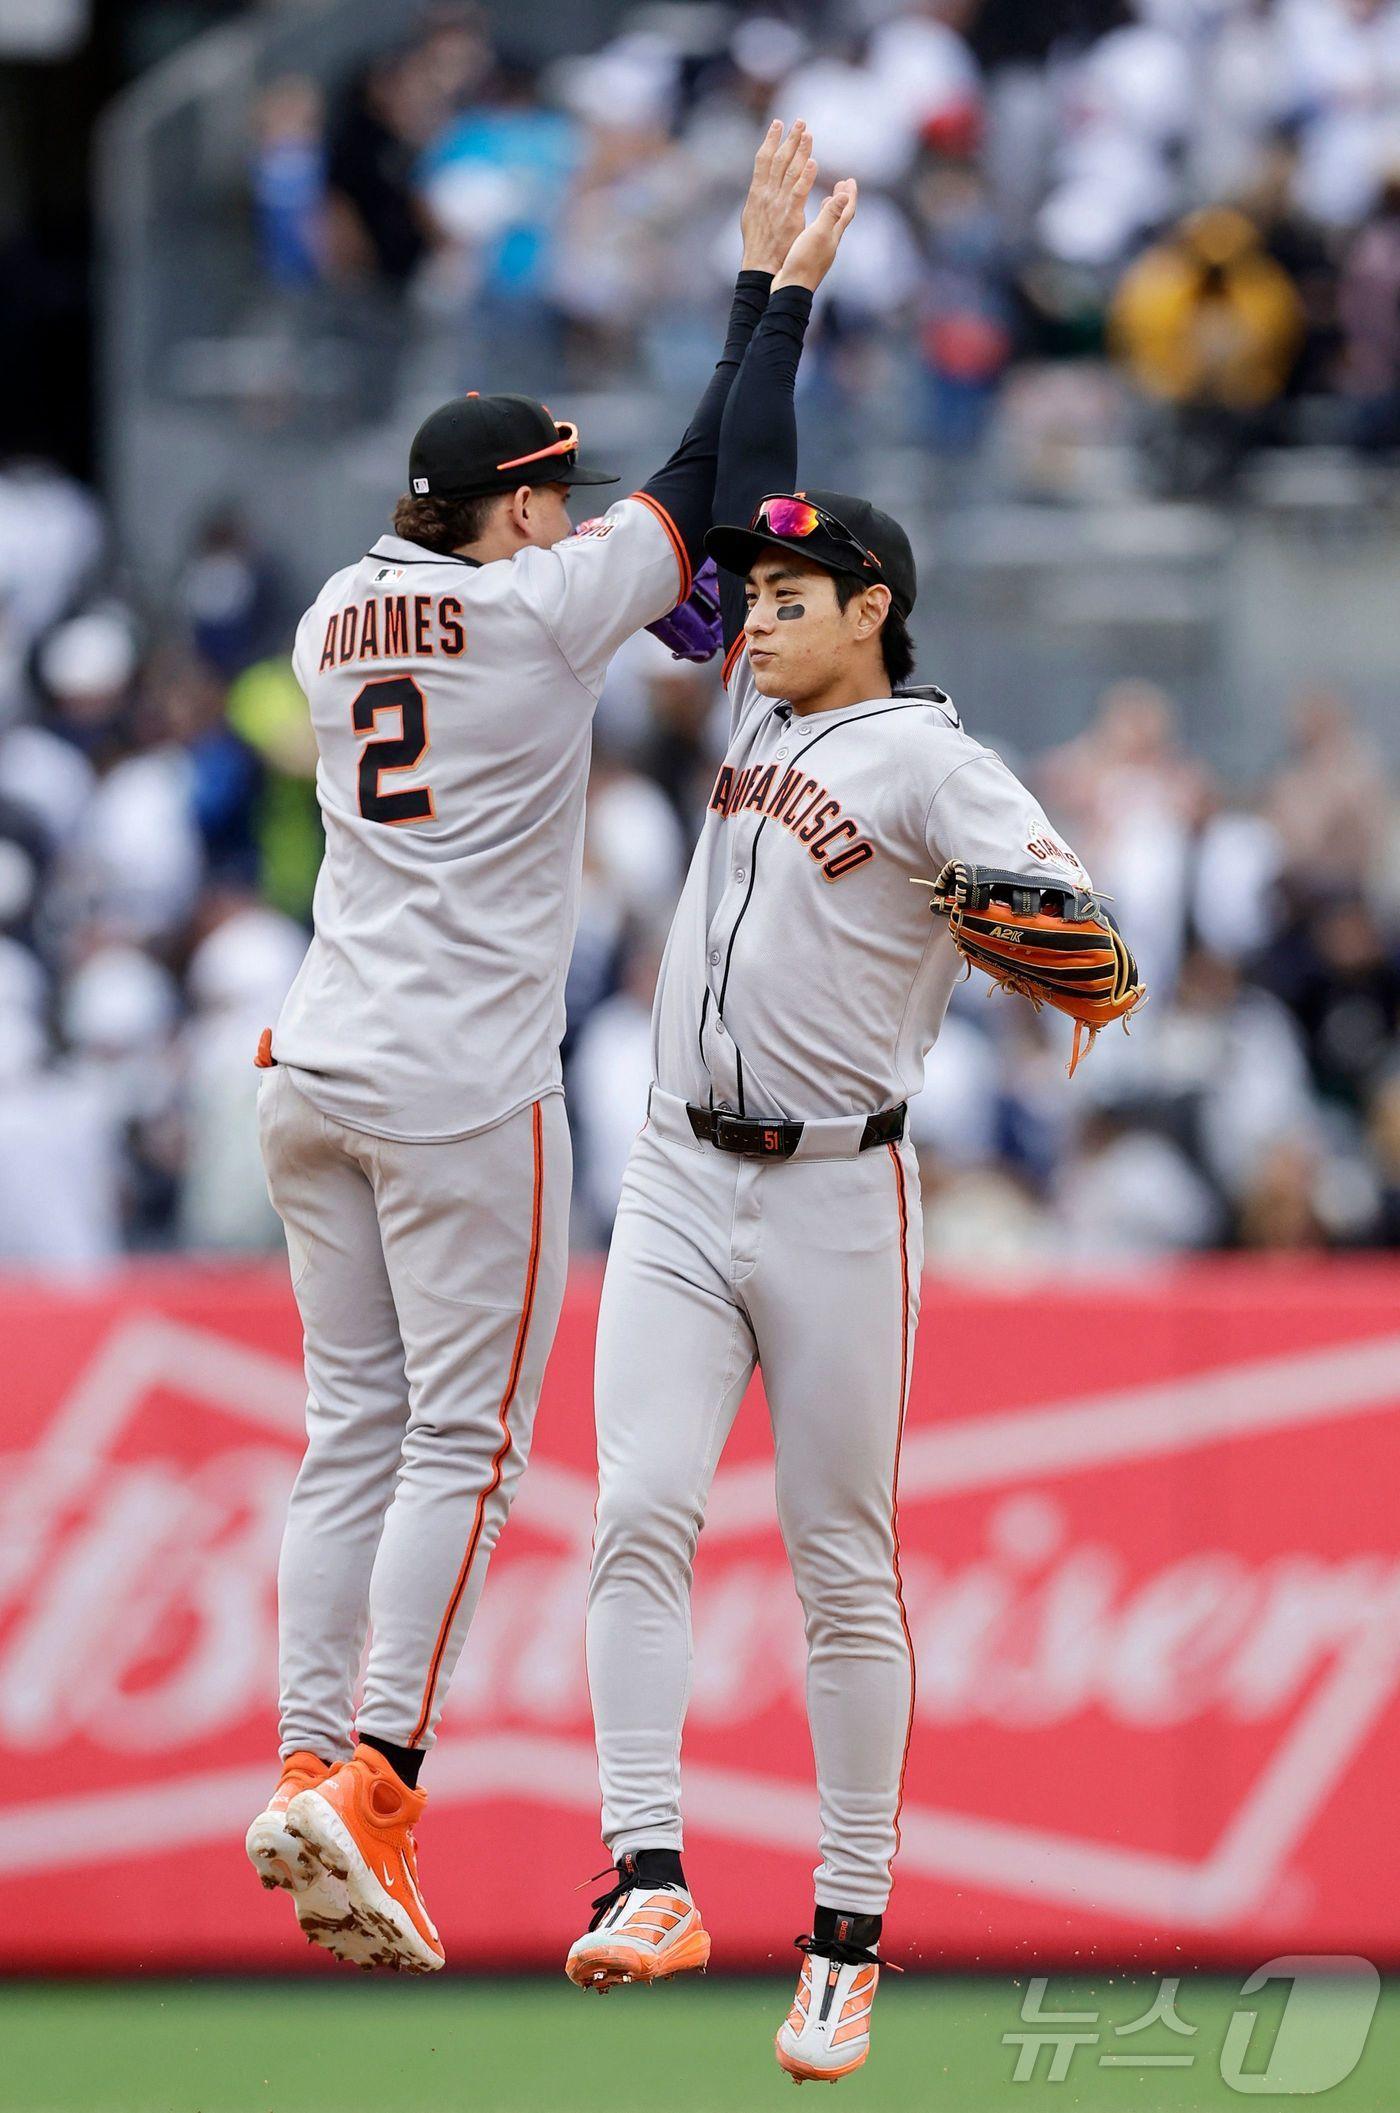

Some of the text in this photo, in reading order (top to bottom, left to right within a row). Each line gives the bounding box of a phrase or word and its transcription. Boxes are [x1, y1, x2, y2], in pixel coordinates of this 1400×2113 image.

[318, 594, 467, 675] ADAMES
[351, 673, 438, 826] 2
[707, 763, 876, 884] AN FANCISCO
[988, 926, 1024, 943] A2K
[764, 1130, 779, 1150] 51
